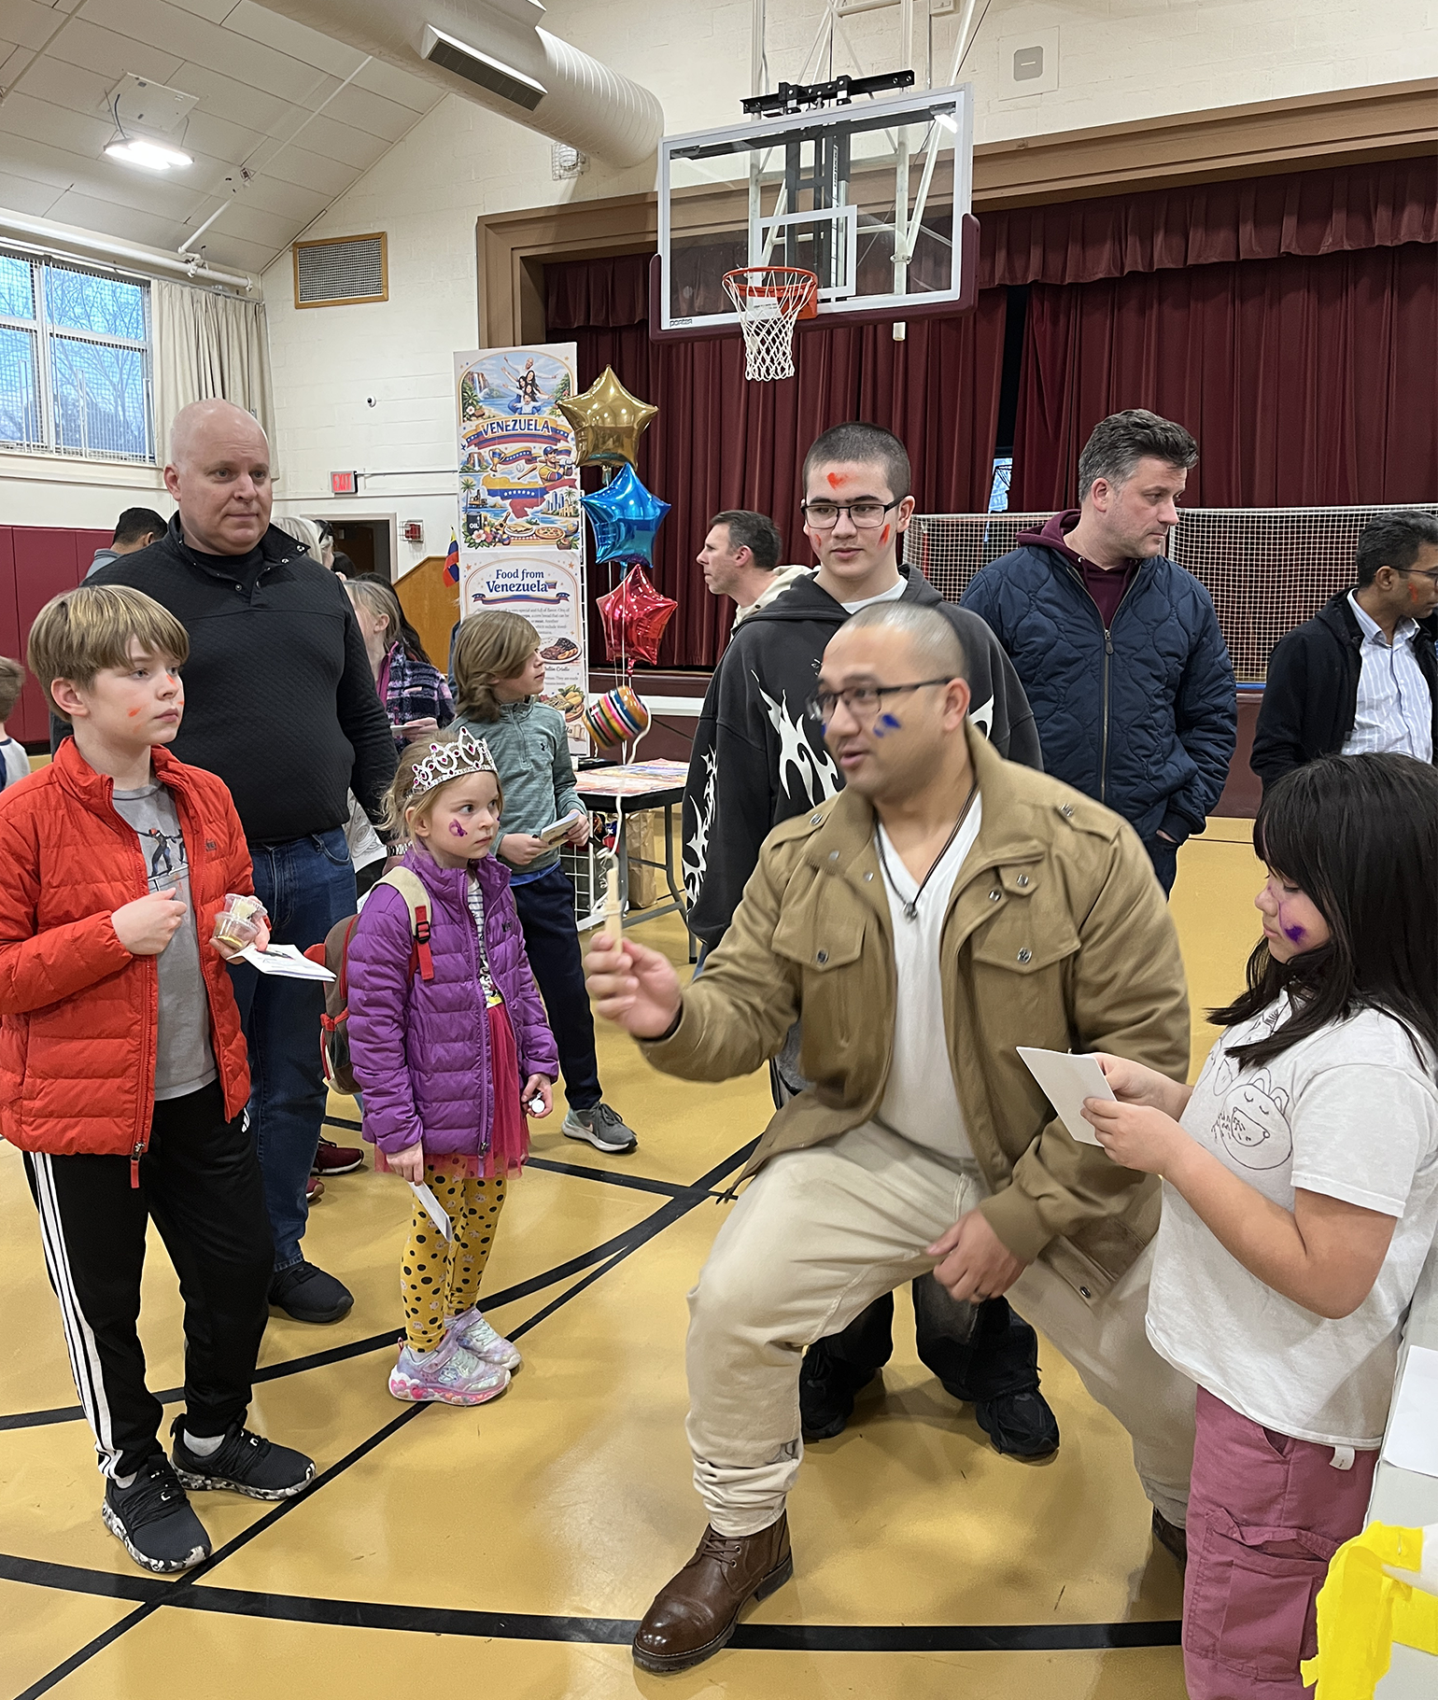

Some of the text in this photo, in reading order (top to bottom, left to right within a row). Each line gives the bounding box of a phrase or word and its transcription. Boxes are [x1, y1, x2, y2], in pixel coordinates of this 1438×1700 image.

[481, 418, 552, 437] VENEZUELA
[332, 473, 352, 492] EXIT
[495, 568, 545, 581] Food from
[486, 579, 549, 593] Venezuela
